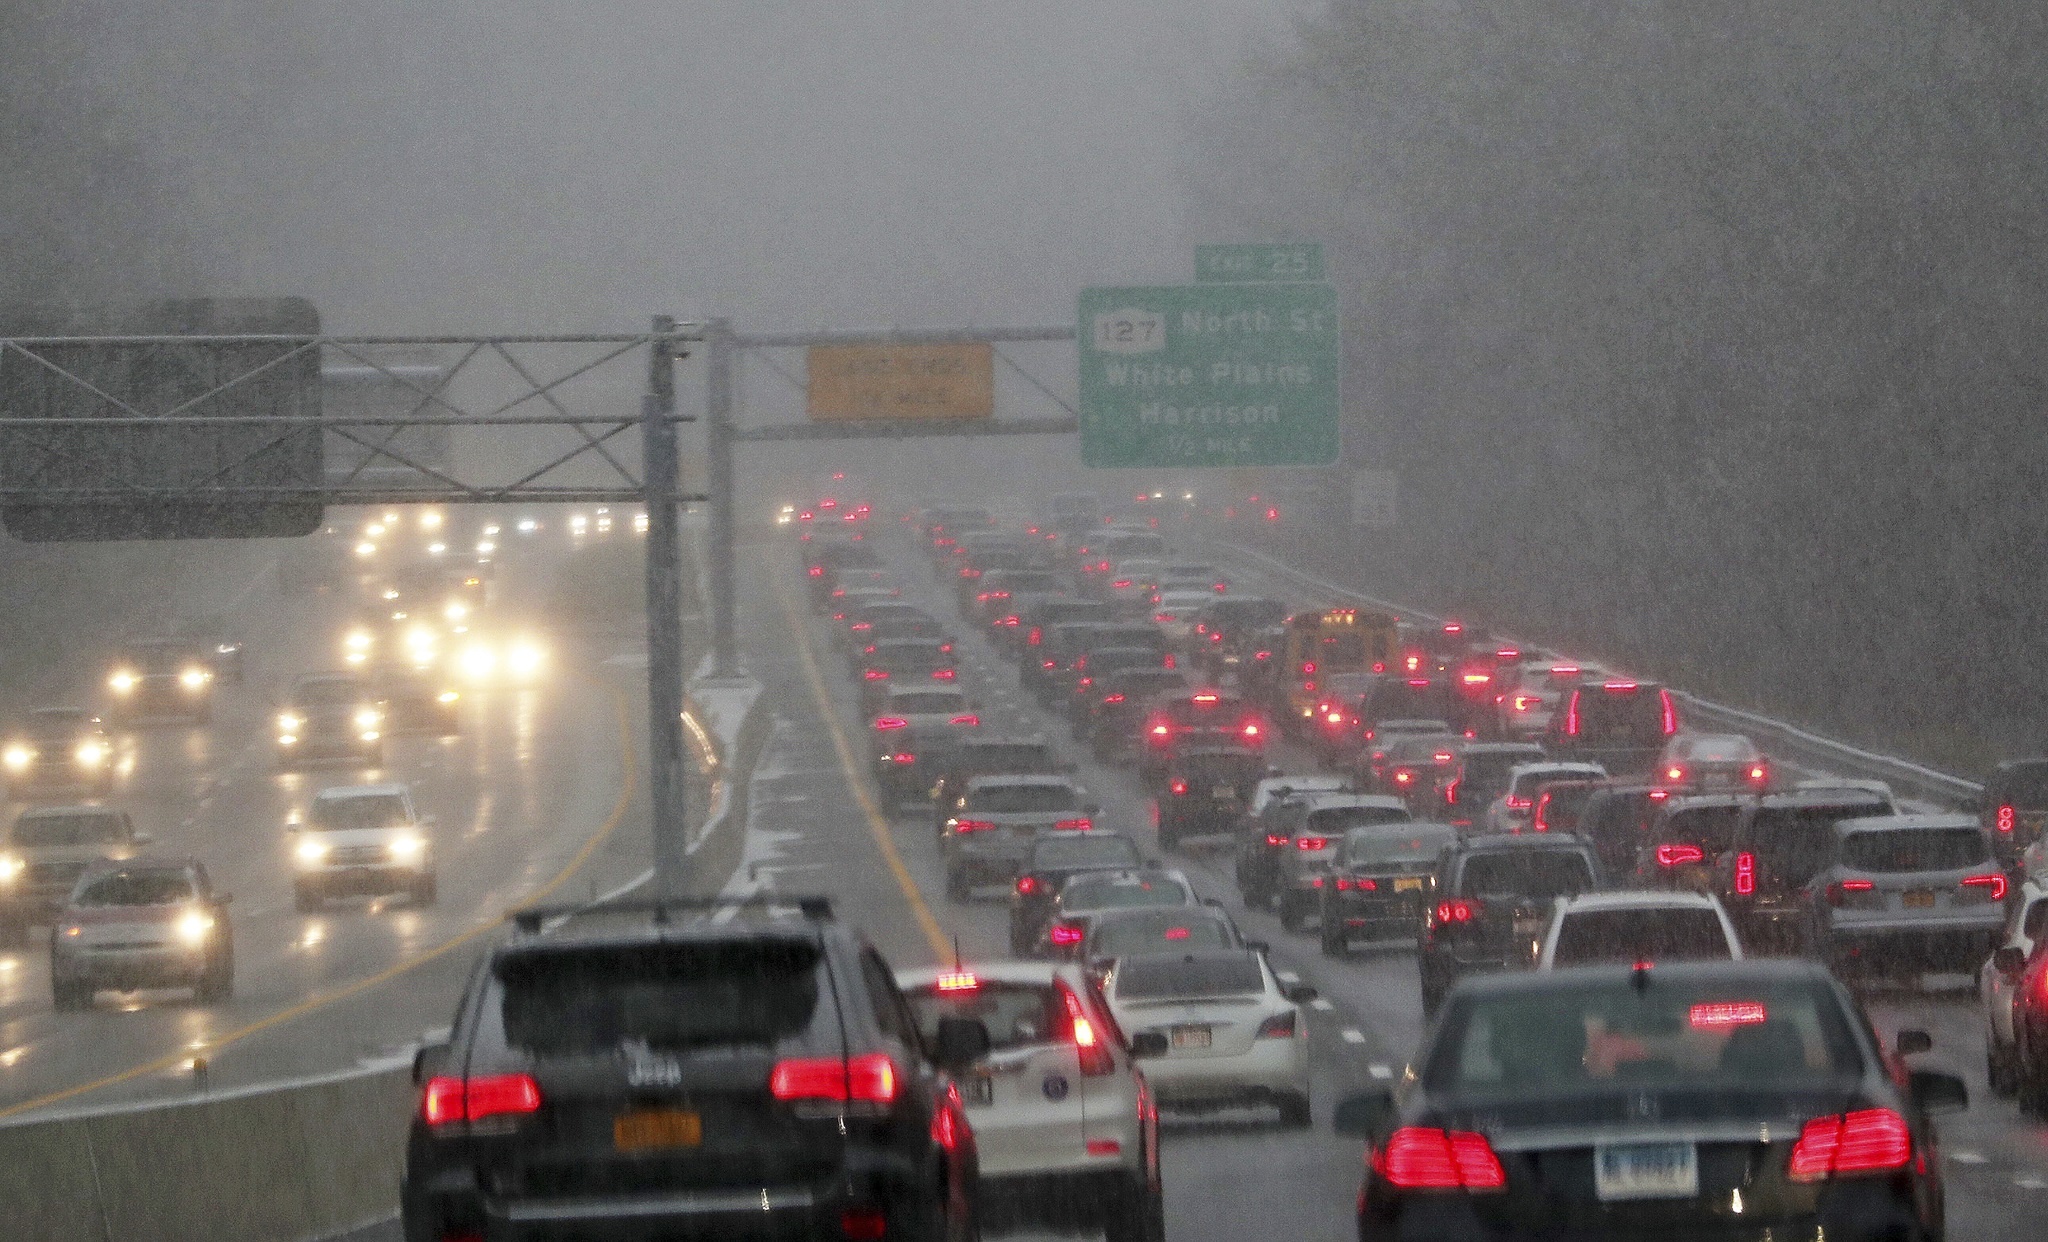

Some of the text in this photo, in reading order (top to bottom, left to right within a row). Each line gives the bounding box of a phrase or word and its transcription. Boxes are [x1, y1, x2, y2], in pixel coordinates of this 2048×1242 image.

[1271, 252, 1309, 274] 25
[1103, 320, 1157, 342] 127
[1182, 308, 1324, 332] North St
[1105, 362, 1312, 386] White Plains
[1140, 403, 1280, 425] Harrison
[627, 1054, 682, 1087] Jeep
